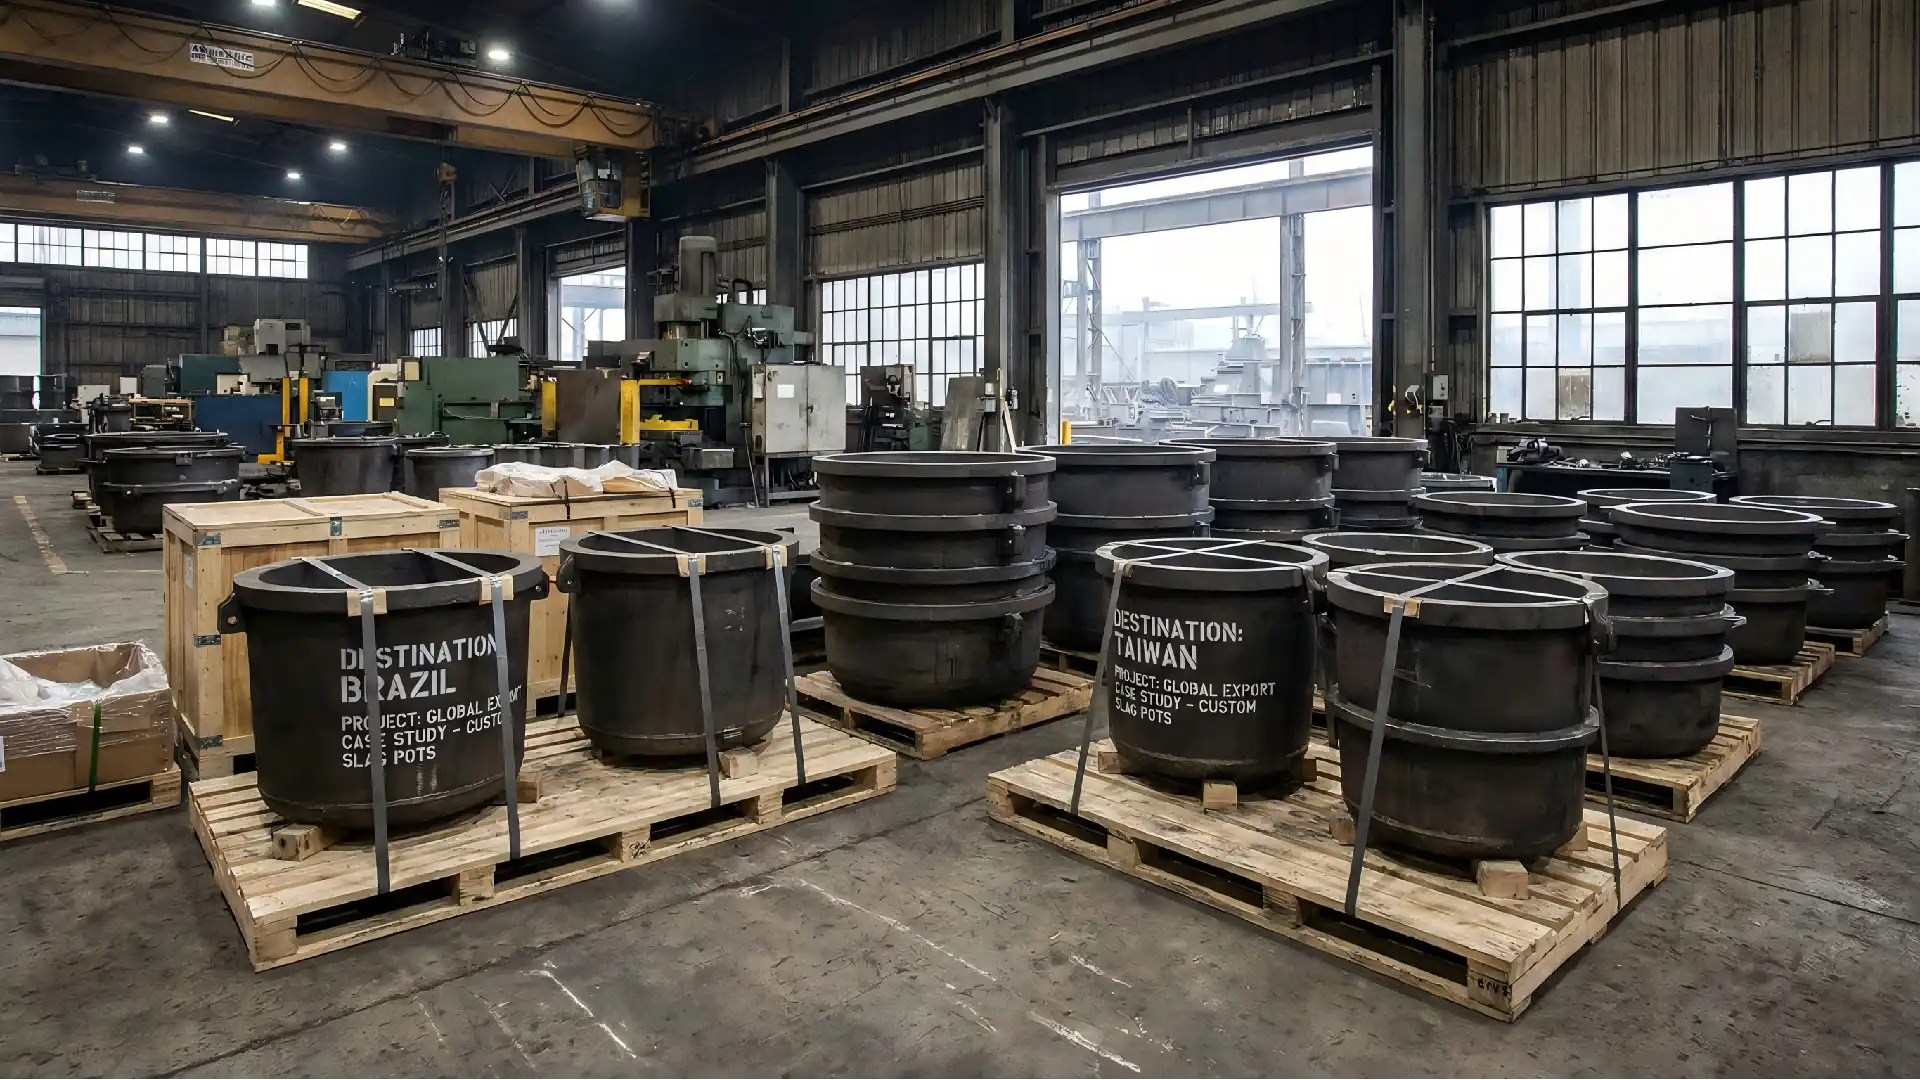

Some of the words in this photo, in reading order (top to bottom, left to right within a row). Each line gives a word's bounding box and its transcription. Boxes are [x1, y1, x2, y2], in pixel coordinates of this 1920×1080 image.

[1114, 608, 1243, 642] DESTINATION:
[1114, 631, 1197, 670] TAIWAN
[1114, 664, 1160, 689] PROJECT:
[1163, 679, 1218, 697] GLOBAL
[1223, 682, 1276, 697] EXPORT
[426, 702, 482, 724] GLOBAL
[487, 685, 522, 711] EXORT
[1115, 681, 1136, 700] CASE
[1140, 690, 1181, 710] STUDY
[1199, 700, 1257, 714] CUSTOM
[1115, 699, 1137, 716] SLAG
[1140, 706, 1172, 725] POTS
[393, 725, 447, 746] STUDY
[466, 712, 503, 734] CUSTO
[394, 746, 436, 764] POTS
